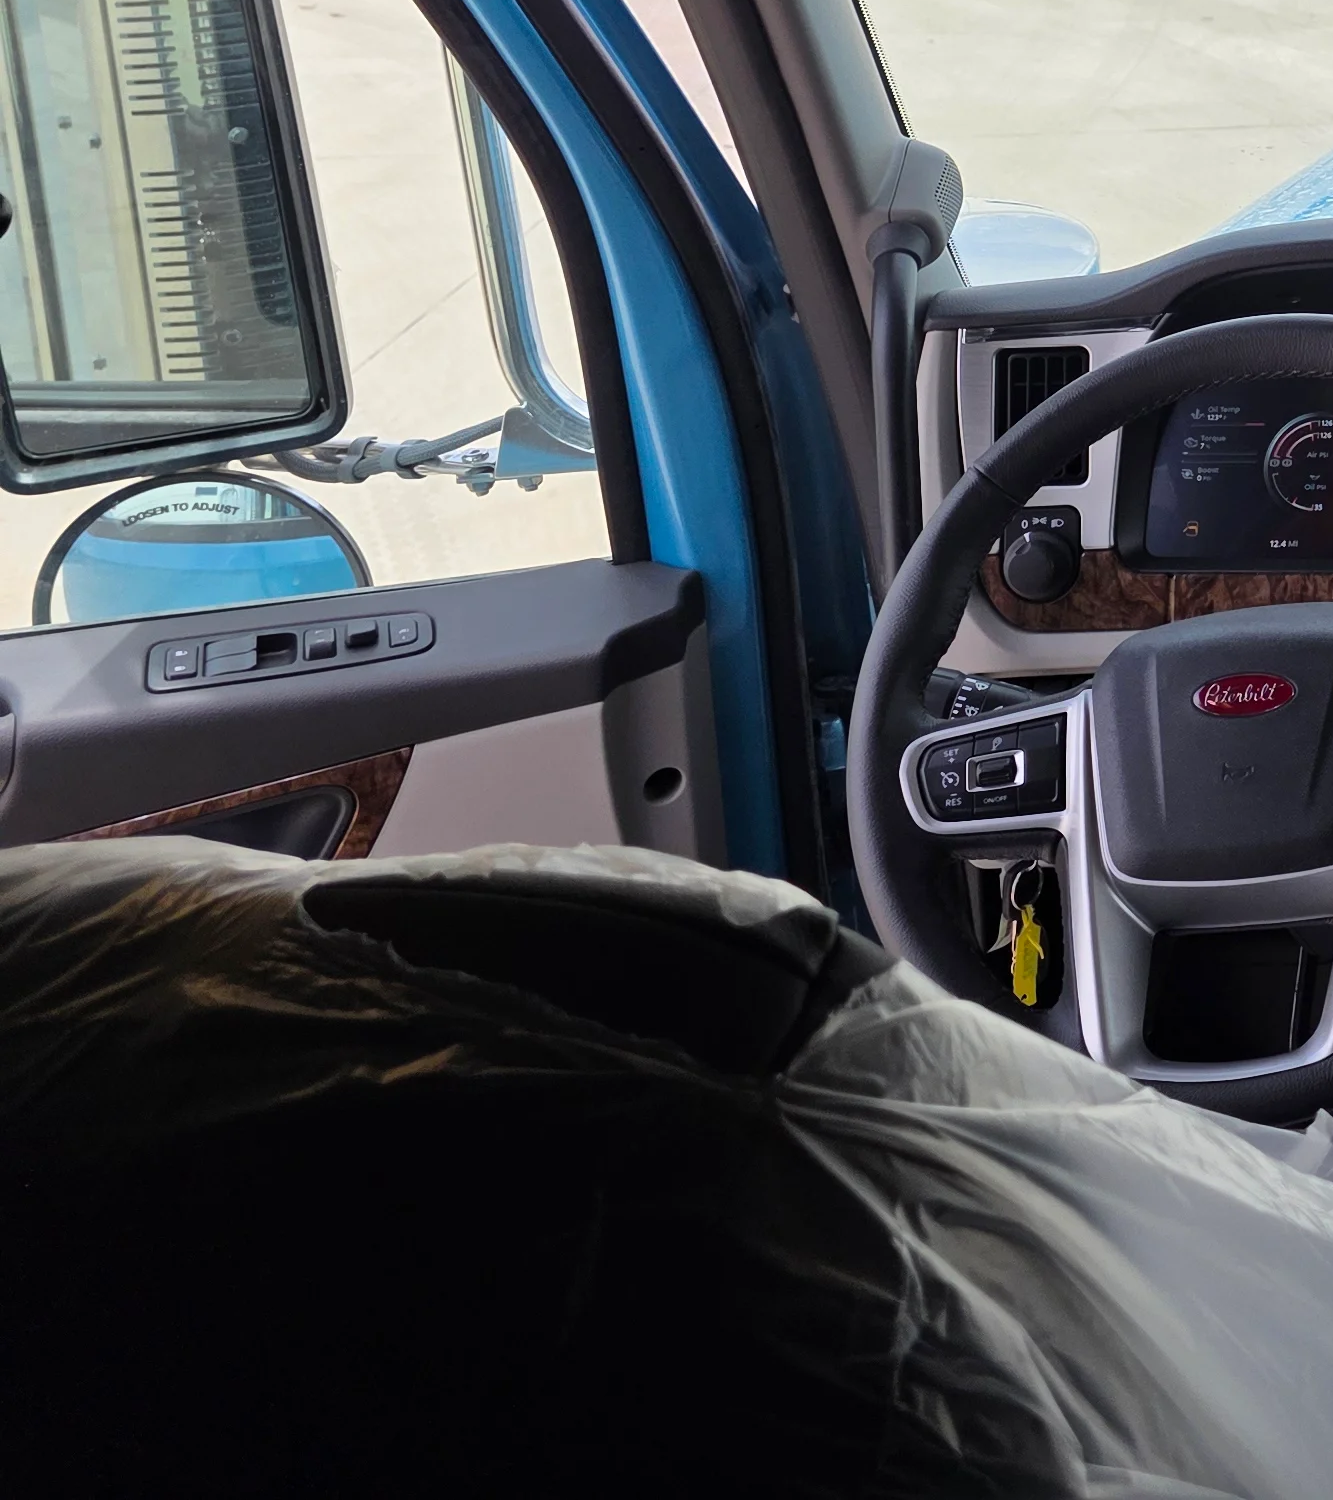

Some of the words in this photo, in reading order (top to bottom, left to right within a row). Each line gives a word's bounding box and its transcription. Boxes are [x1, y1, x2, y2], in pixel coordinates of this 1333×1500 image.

[1207, 406, 1219, 414] Oil
[1220, 406, 1241, 415] Temp
[1200, 435, 1227, 443] Torque
[1304, 483, 1315, 491] Oil
[122, 504, 169, 527] LOOSEN
[171, 501, 189, 512] TO
[191, 501, 241, 517] ADJUST
[1269, 539, 1287, 548] 12.4
[1204, 681, 1285, 707] Peterbilt
[943, 748, 960, 758] SET
[945, 797, 962, 807] RES
[982, 794, 1008, 804] ON/OFF
